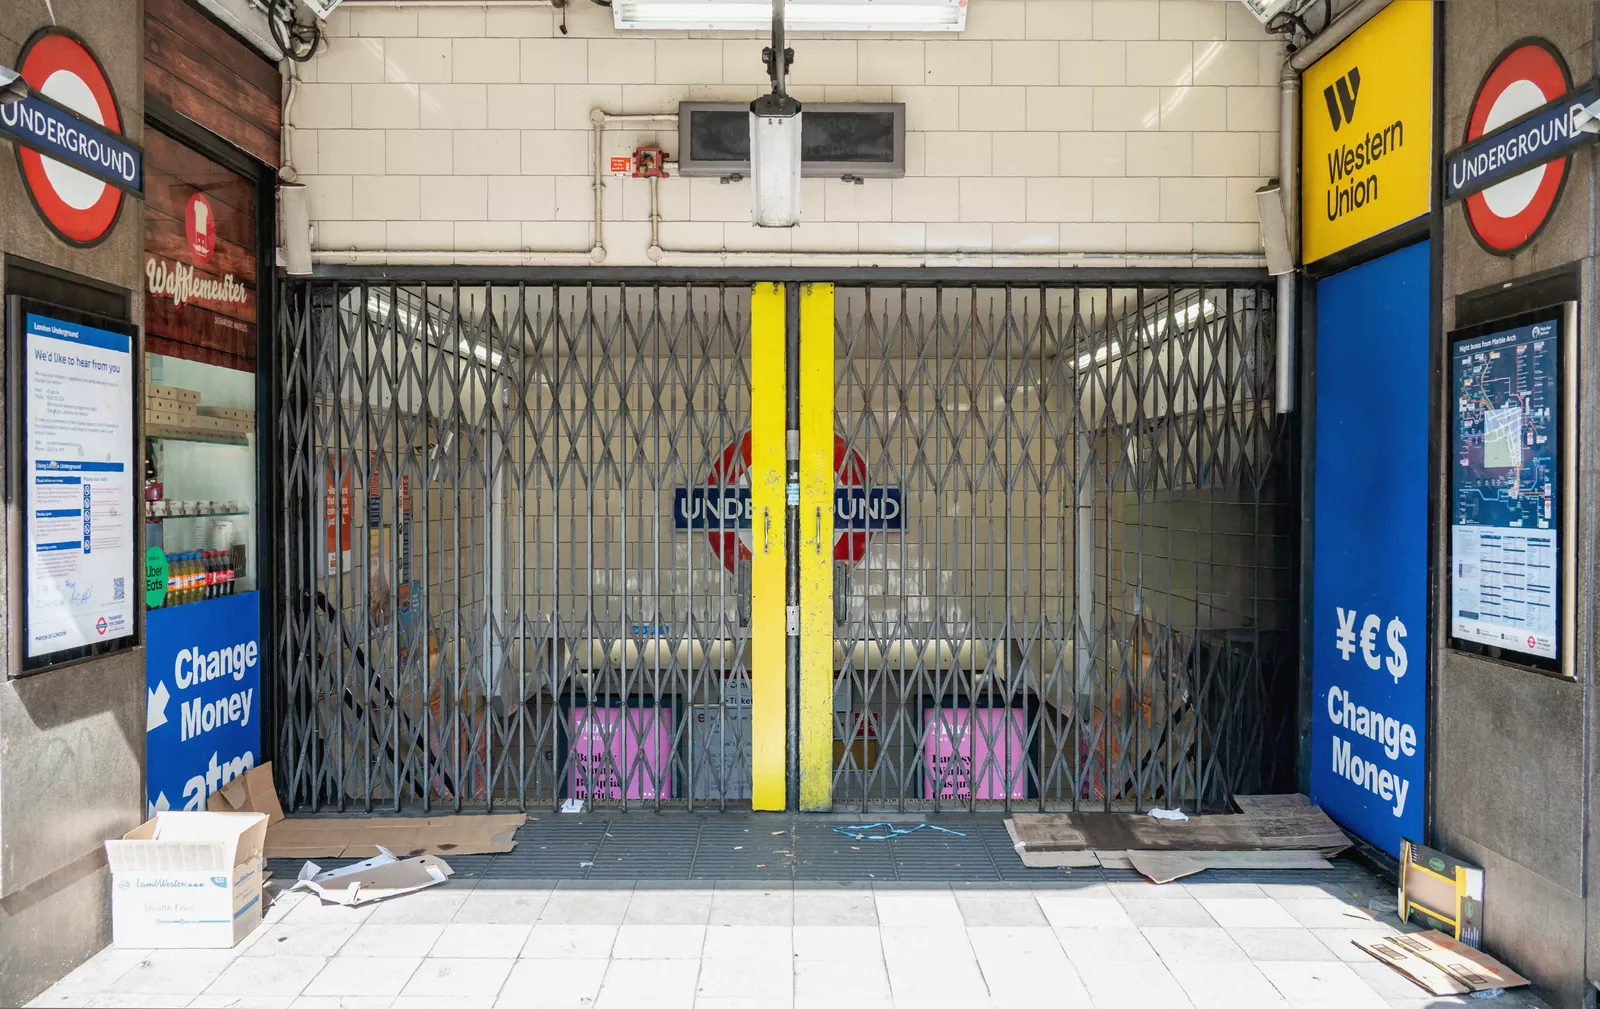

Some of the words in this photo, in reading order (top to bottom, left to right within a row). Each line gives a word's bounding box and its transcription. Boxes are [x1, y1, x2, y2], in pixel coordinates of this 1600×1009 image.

[0, 100, 136, 182] UNDERGROUND
[1327, 119, 1404, 185] Western
[1453, 102, 1586, 190] UNDERGROUND
[1327, 174, 1378, 222] Union
[146, 258, 248, 306] Wafflemeister
[33, 321, 51, 332] London
[51, 326, 79, 338] Underground
[1459, 345, 1471, 353] Night
[1470, 342, 1482, 350] buses
[1491, 337, 1506, 346] Marble
[1506, 334, 1517, 342] Arch
[34, 348, 52, 362] We'd
[53, 351, 67, 365] like
[67, 356, 75, 365] to
[76, 356, 91, 368] hear
[92, 359, 108, 371] from
[109, 364, 121, 374] you
[146, 566, 163, 578] Uber
[146, 580, 163, 592] Eats
[174, 640, 258, 690] Change
[180, 687, 254, 743] Money
[1327, 685, 1417, 761] Change
[1332, 735, 1410, 818] Money
